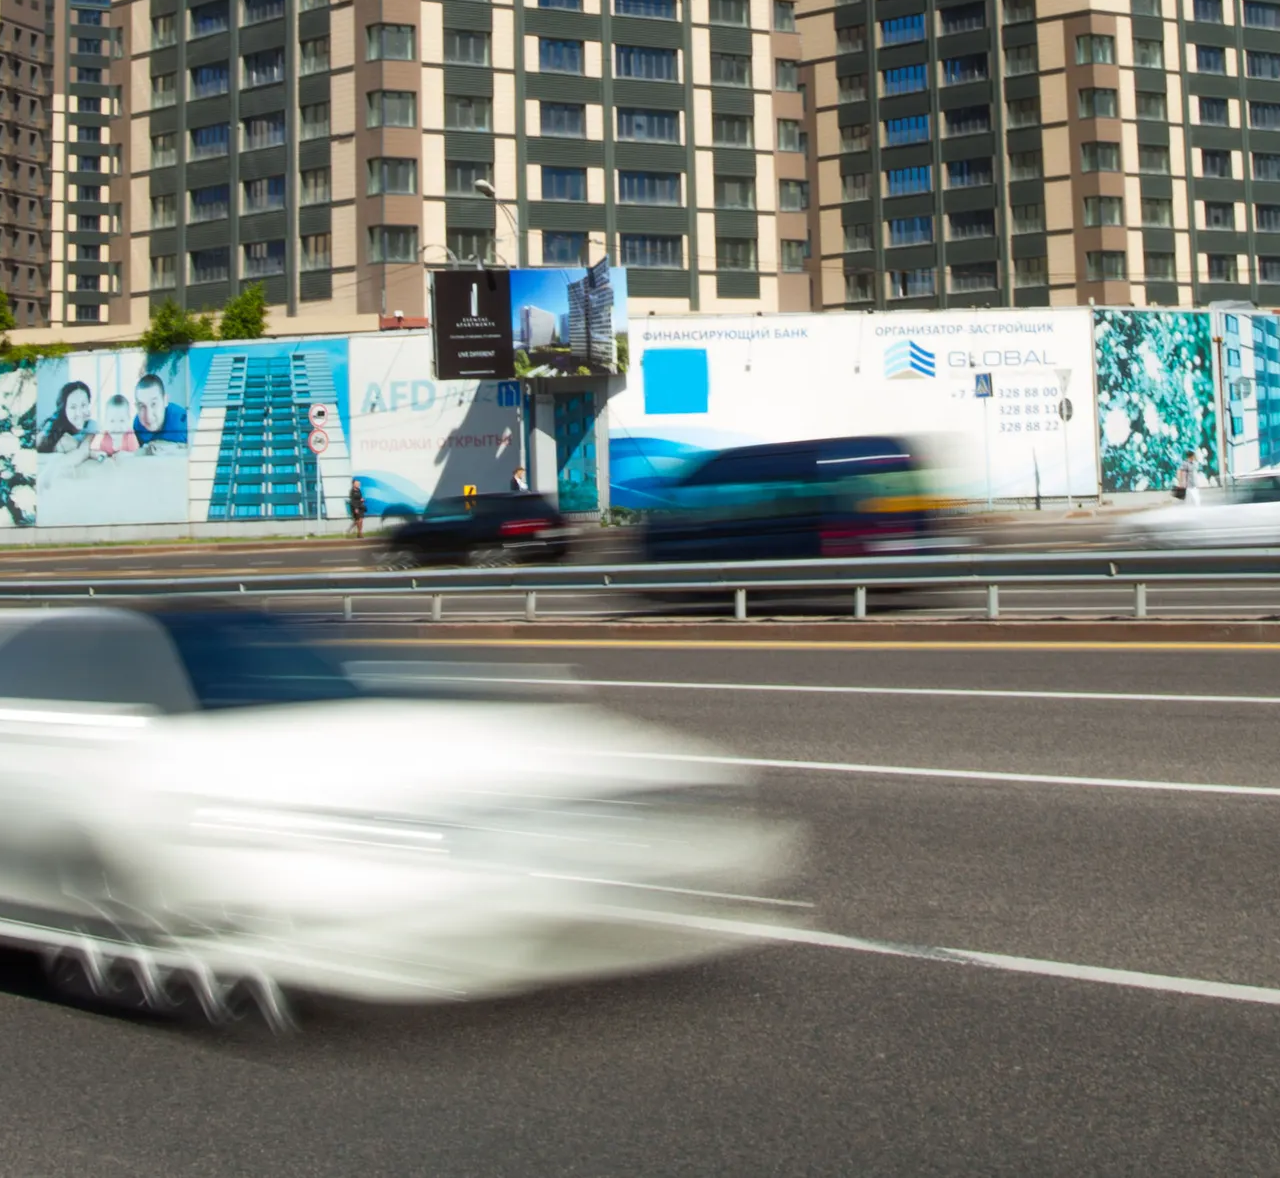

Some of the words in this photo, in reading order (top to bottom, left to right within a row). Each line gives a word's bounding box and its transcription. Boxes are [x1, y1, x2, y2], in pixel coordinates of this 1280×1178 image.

[642, 326, 770, 342] ФИНАНСИРУЮЩИЙ
[774, 328, 808, 340] БАНК
[947, 350, 1058, 368] GLOBAL
[360, 380, 436, 413] AFD
[998, 388, 1020, 399] 328
[1024, 387, 1039, 398] 88
[1043, 387, 1058, 397] 00
[999, 405, 1021, 416] 328
[1025, 404, 1040, 415] 88
[1044, 404, 1058, 414] 11
[999, 422, 1022, 433] 328
[1025, 422, 1041, 432] 88
[1045, 421, 1059, 431] 22
[360, 437, 432, 452] ПРОДАЖИ
